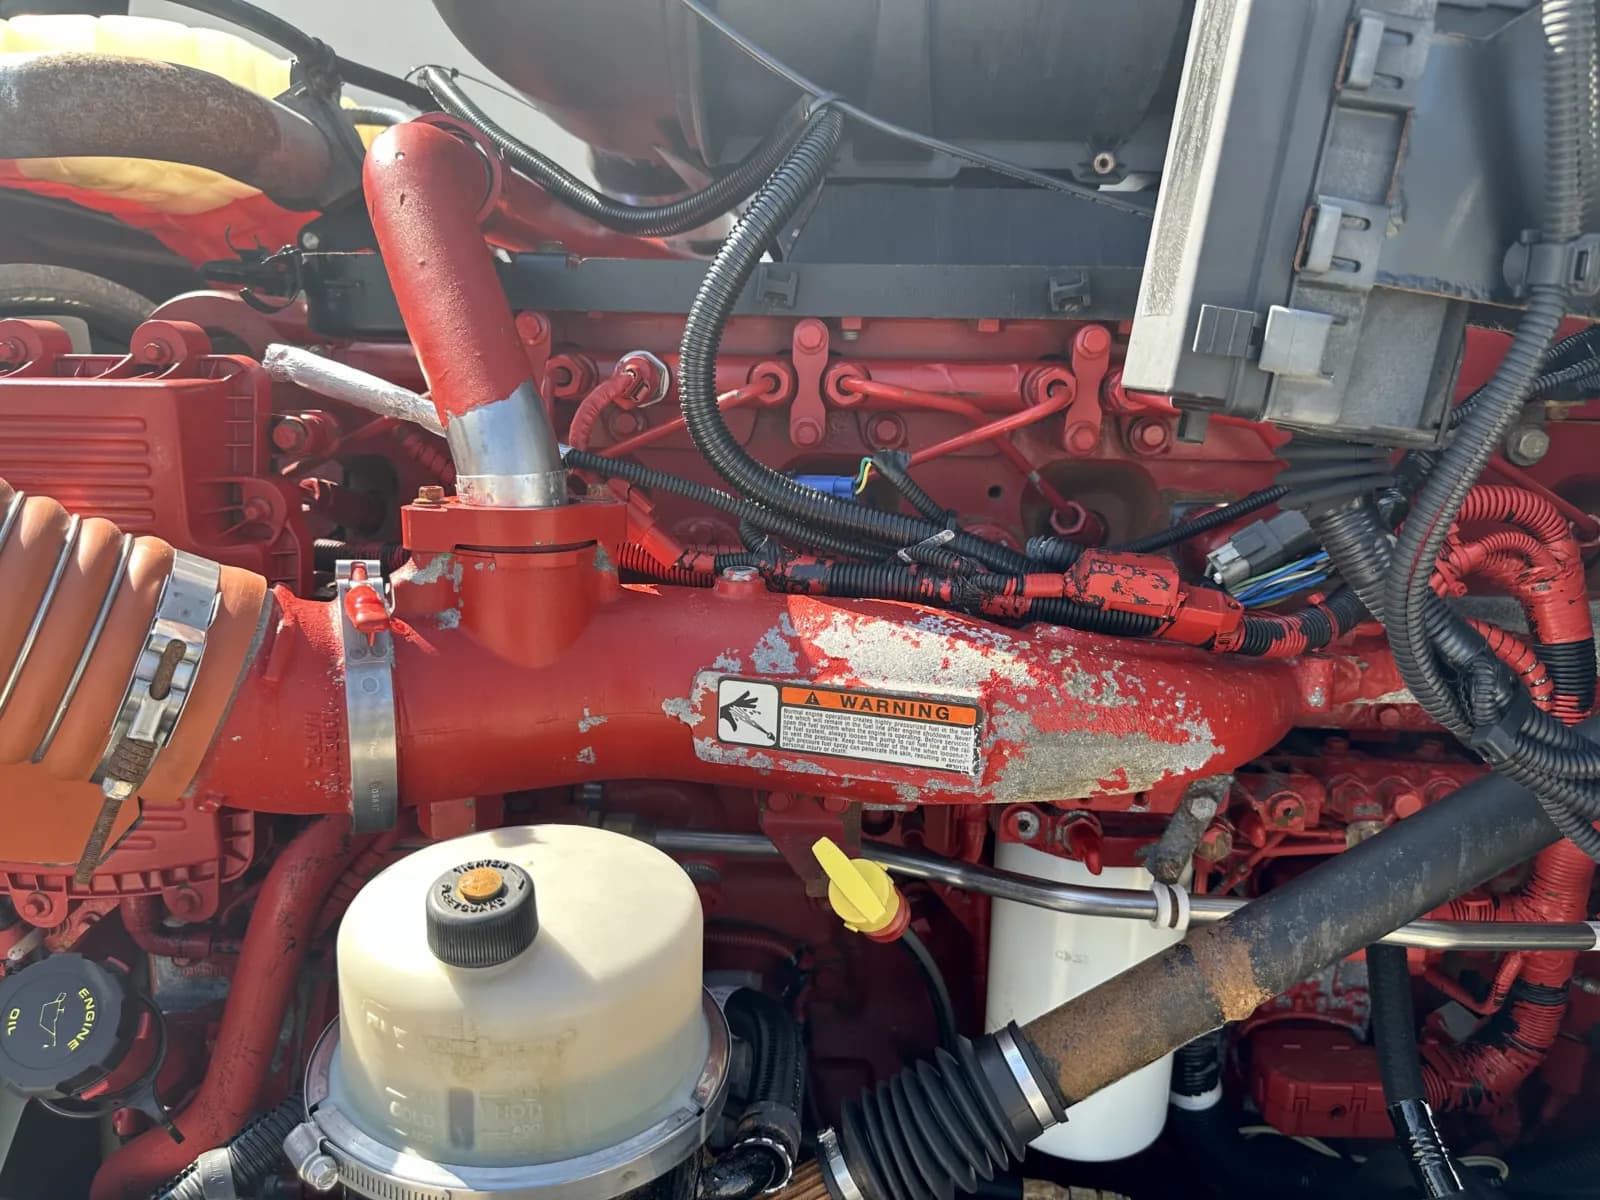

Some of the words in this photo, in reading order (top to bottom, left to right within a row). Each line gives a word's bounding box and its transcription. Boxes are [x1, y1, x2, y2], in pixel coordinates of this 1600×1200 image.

[840, 695, 950, 721] WARNING
[7, 1008, 21, 1036] OIL
[67, 987, 95, 1051] ENGINE
